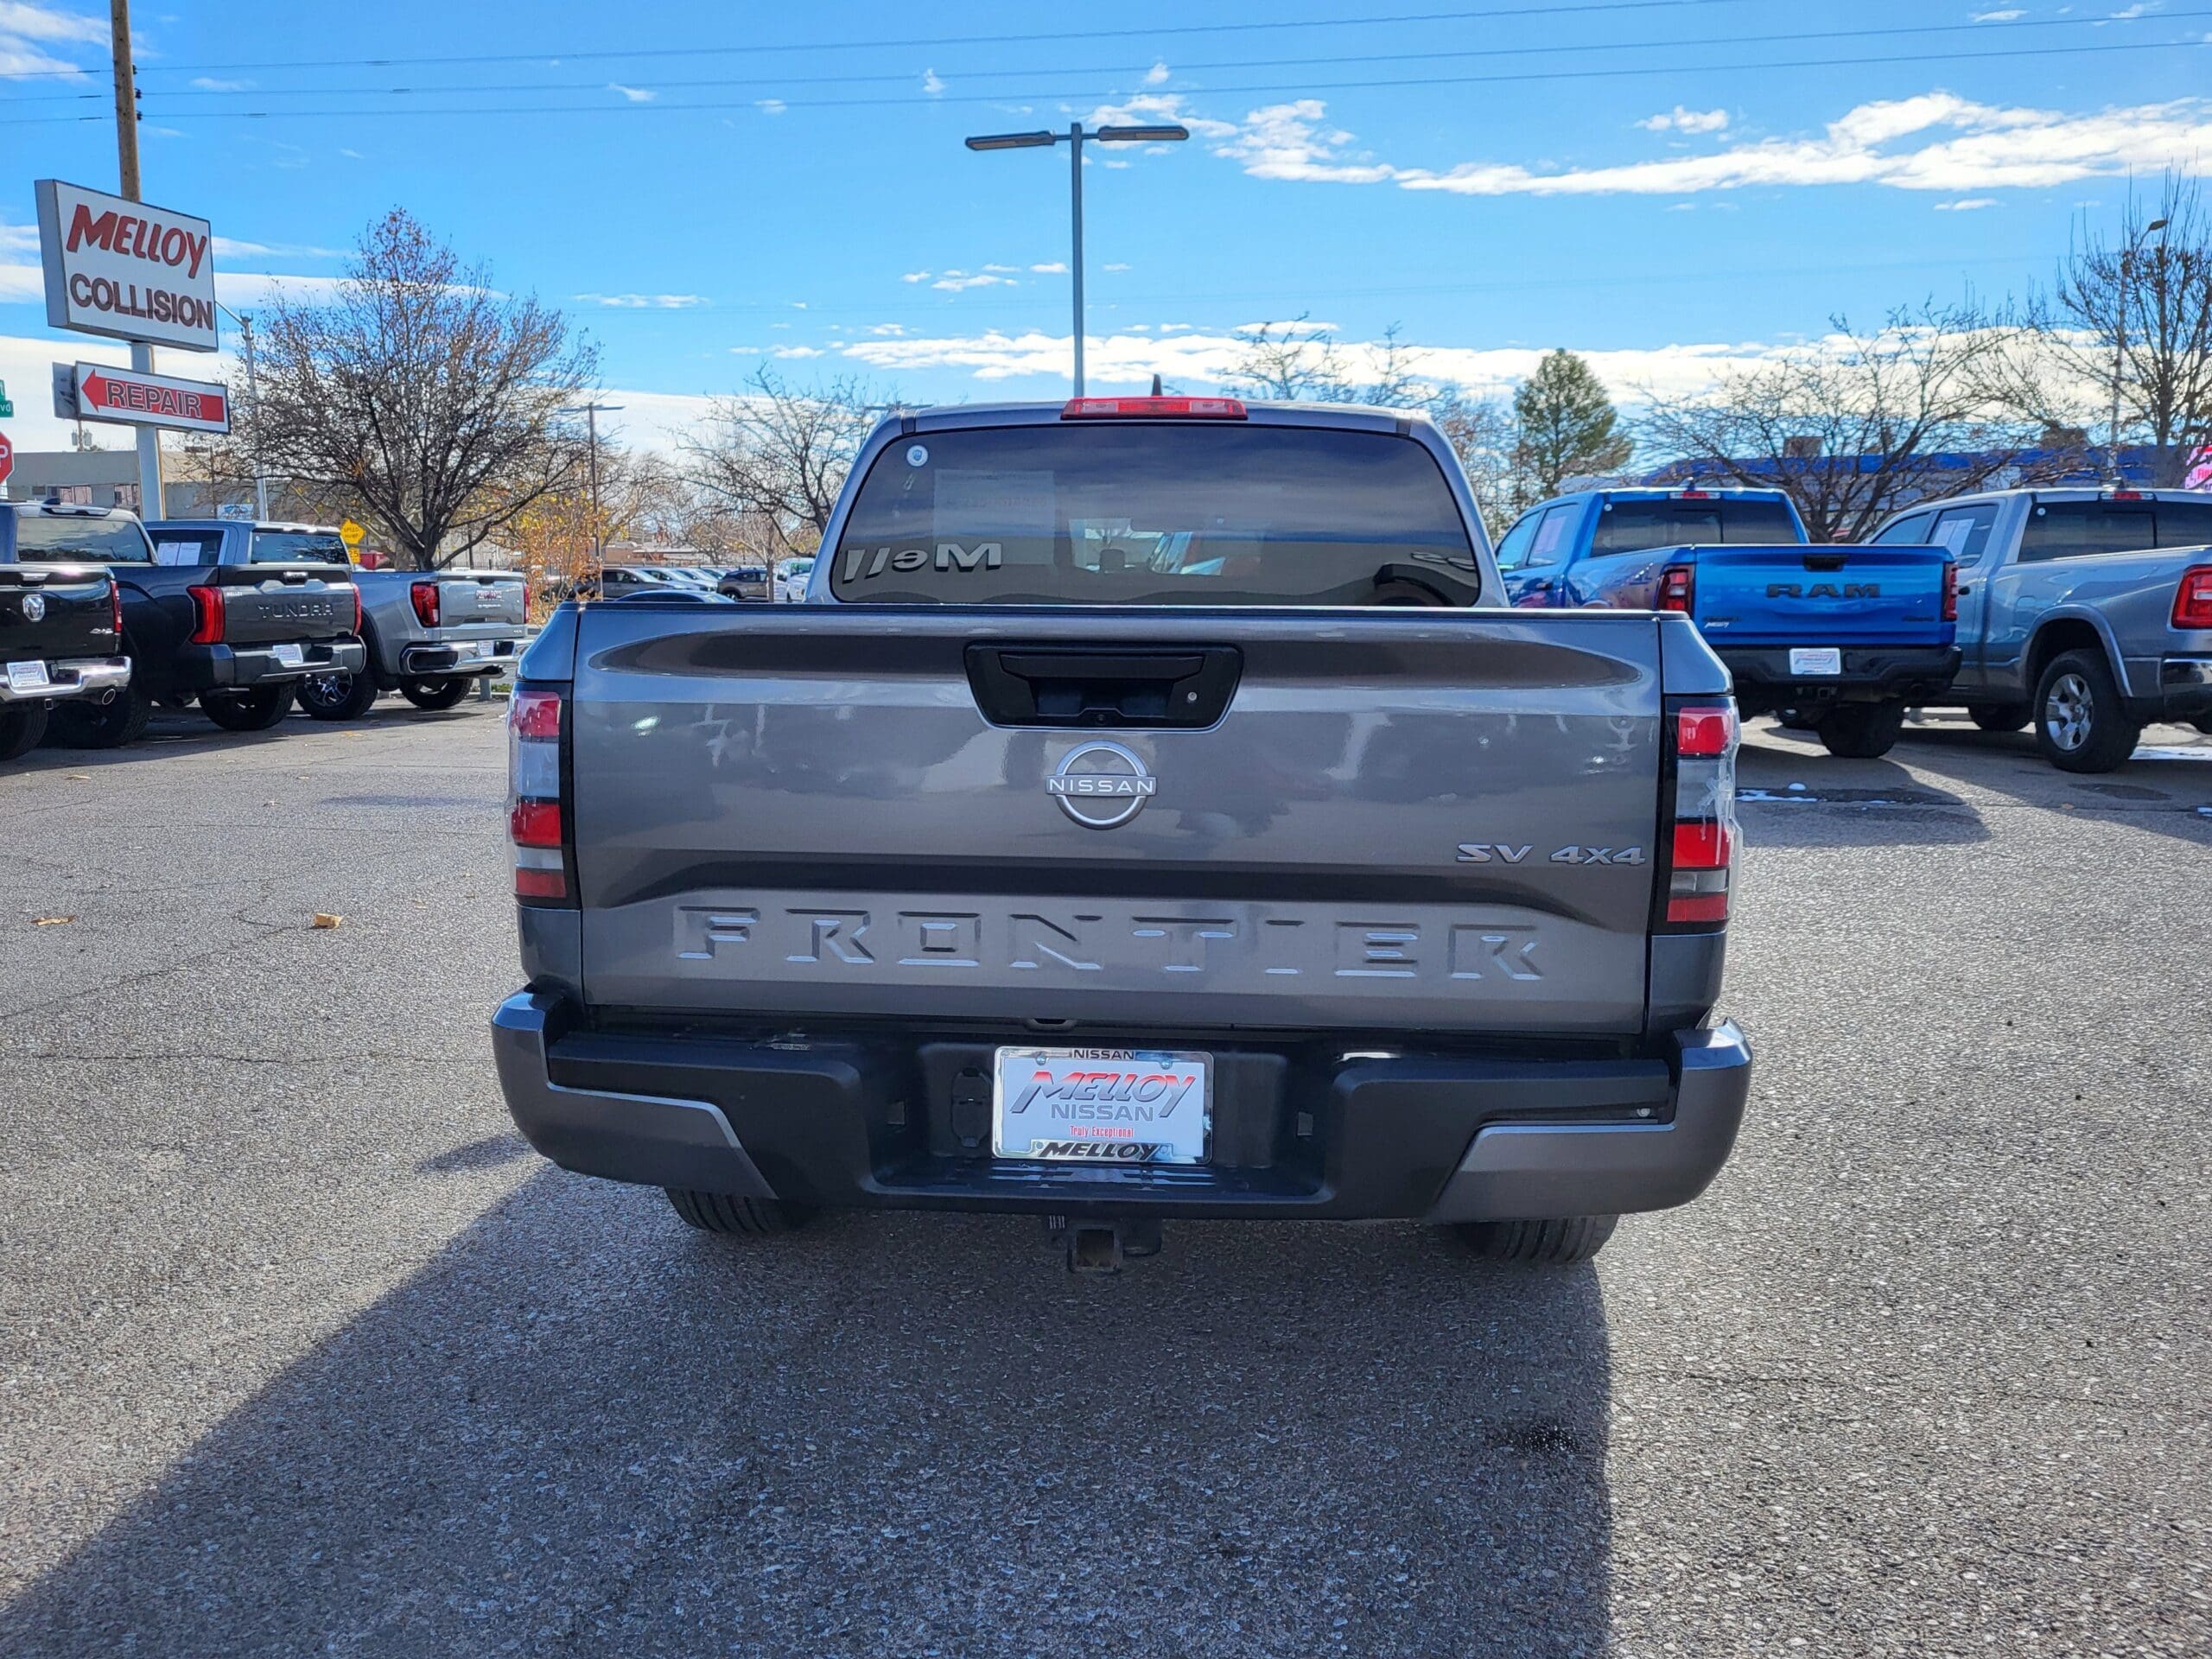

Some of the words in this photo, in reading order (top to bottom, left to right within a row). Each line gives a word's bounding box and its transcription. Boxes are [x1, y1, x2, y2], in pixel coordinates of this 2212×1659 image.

[67, 204, 207, 279] MELLOY
[70, 273, 213, 330] COLLISION
[105, 380, 202, 418] REPAIR
[1766, 583, 1881, 598] RAM
[257, 605, 334, 619] TUNDRA
[1049, 779, 1154, 793] NISSAN
[1457, 843, 1535, 863] SV
[672, 906, 1542, 981] FRONTIER
[1073, 1049, 1135, 1060] NISSAN
[1009, 1071, 1197, 1118] MELLOY
[1051, 1103, 1154, 1122] NISSAN
[1070, 1125, 1089, 1137] Truly
[1091, 1126, 1134, 1138] Exceptional
[1037, 1141, 1161, 1160] MELLOY
